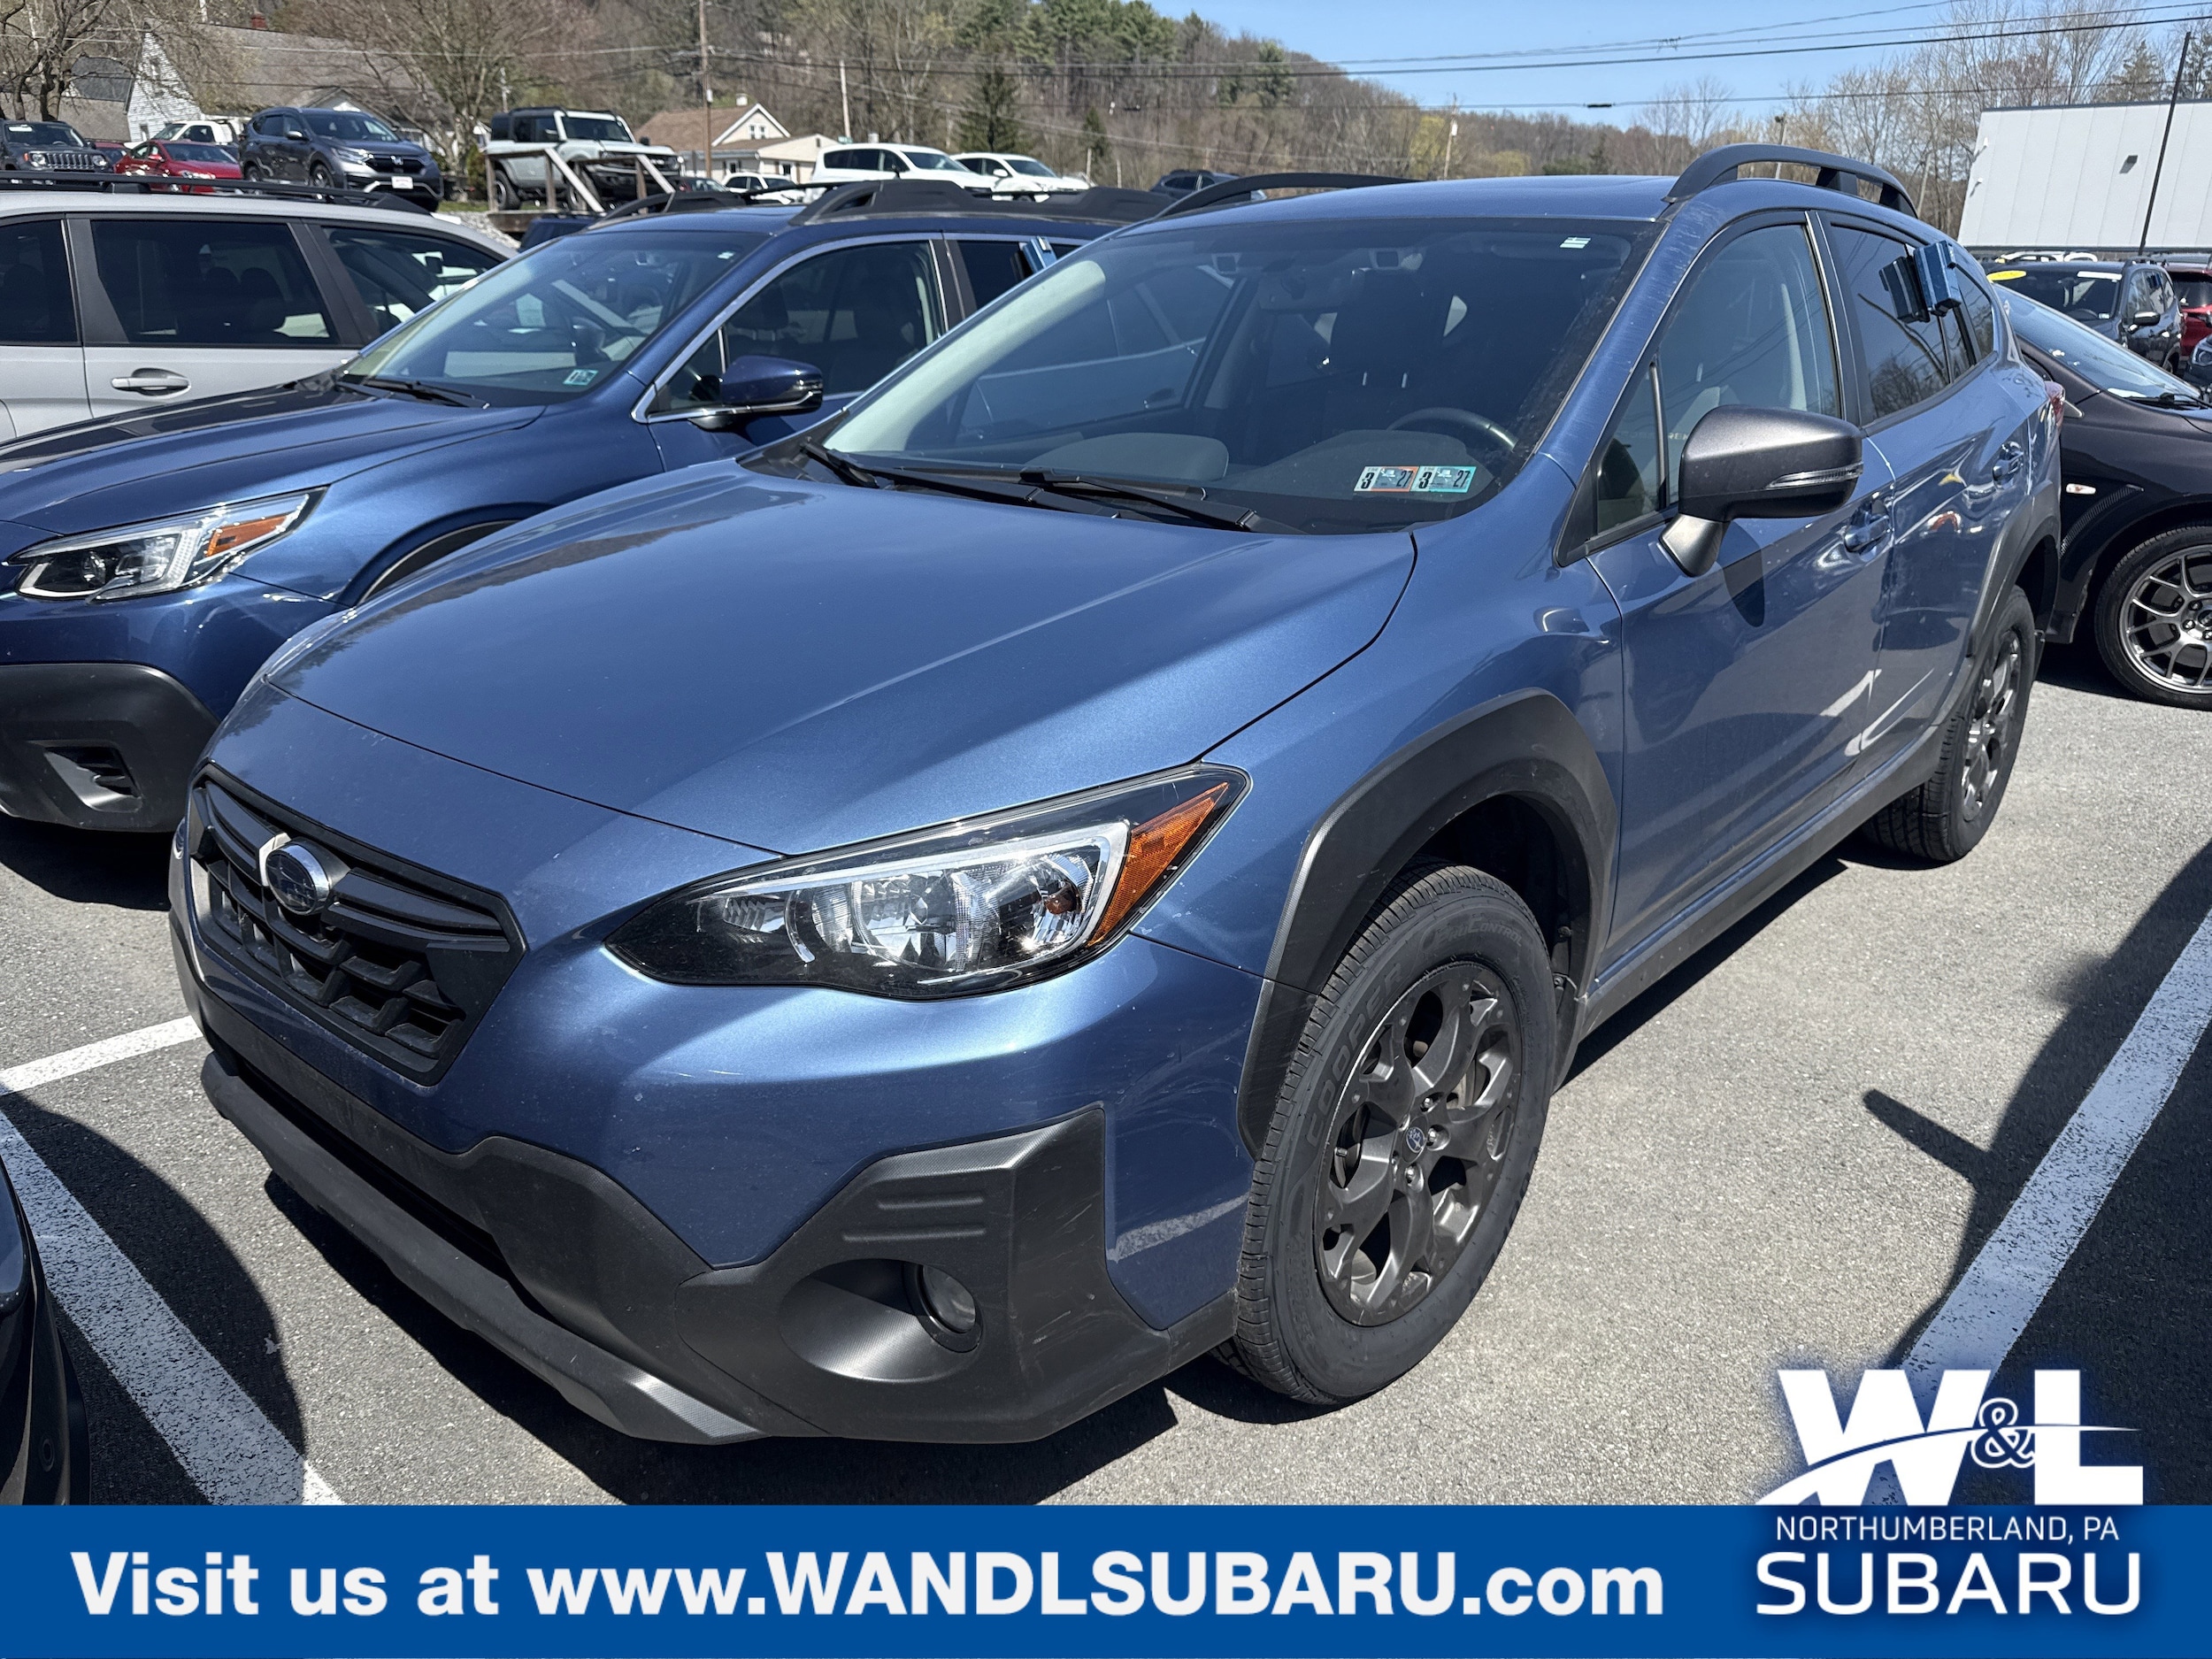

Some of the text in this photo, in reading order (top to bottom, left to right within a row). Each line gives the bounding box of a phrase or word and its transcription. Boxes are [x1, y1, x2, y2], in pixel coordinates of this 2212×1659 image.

[1361, 470, 1413, 489] 3 27
[1418, 470, 1471, 489] 3 27
[1305, 963, 1402, 1148] COOPER
